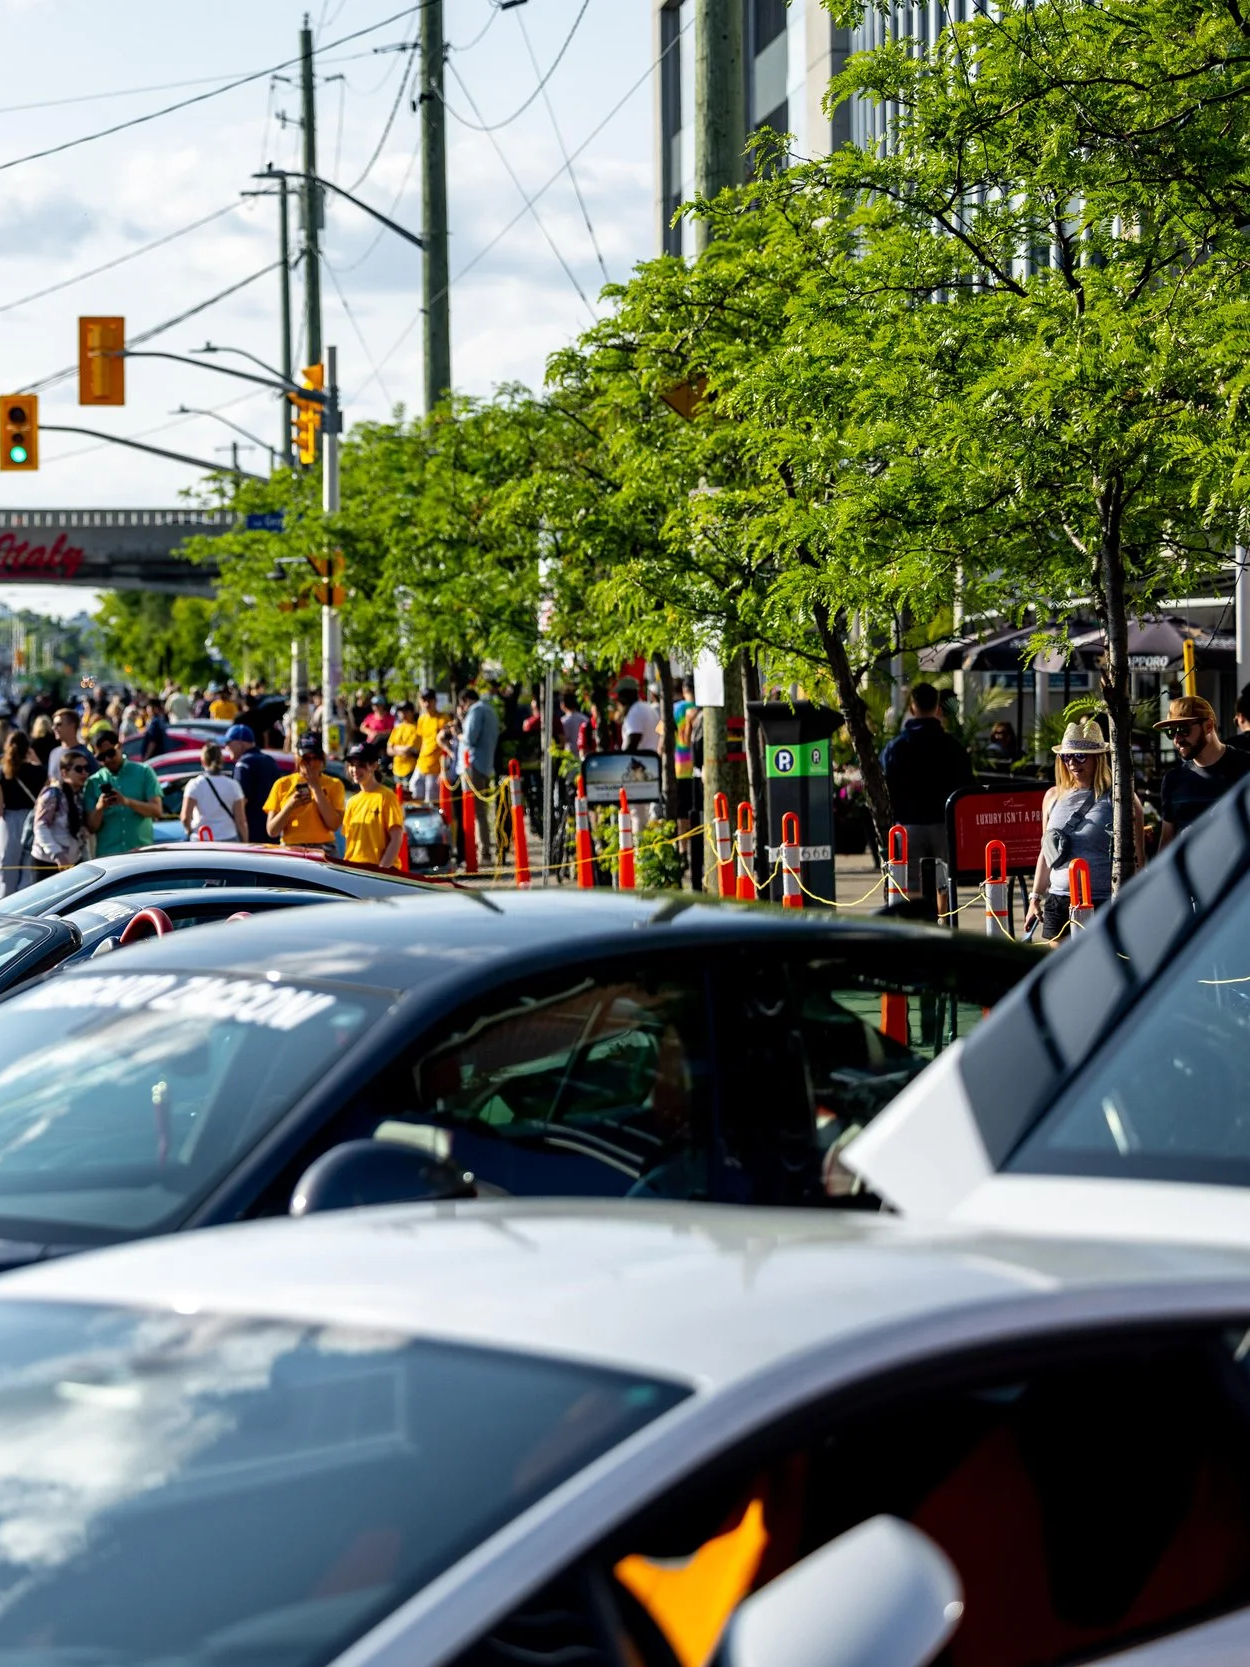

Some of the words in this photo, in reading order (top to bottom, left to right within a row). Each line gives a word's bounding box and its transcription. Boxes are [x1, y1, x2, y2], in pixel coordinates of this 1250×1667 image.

[975, 812, 1003, 825] LUXURY
[1004, 811, 1022, 824] ISN'T
[1024, 811, 1030, 822] A
